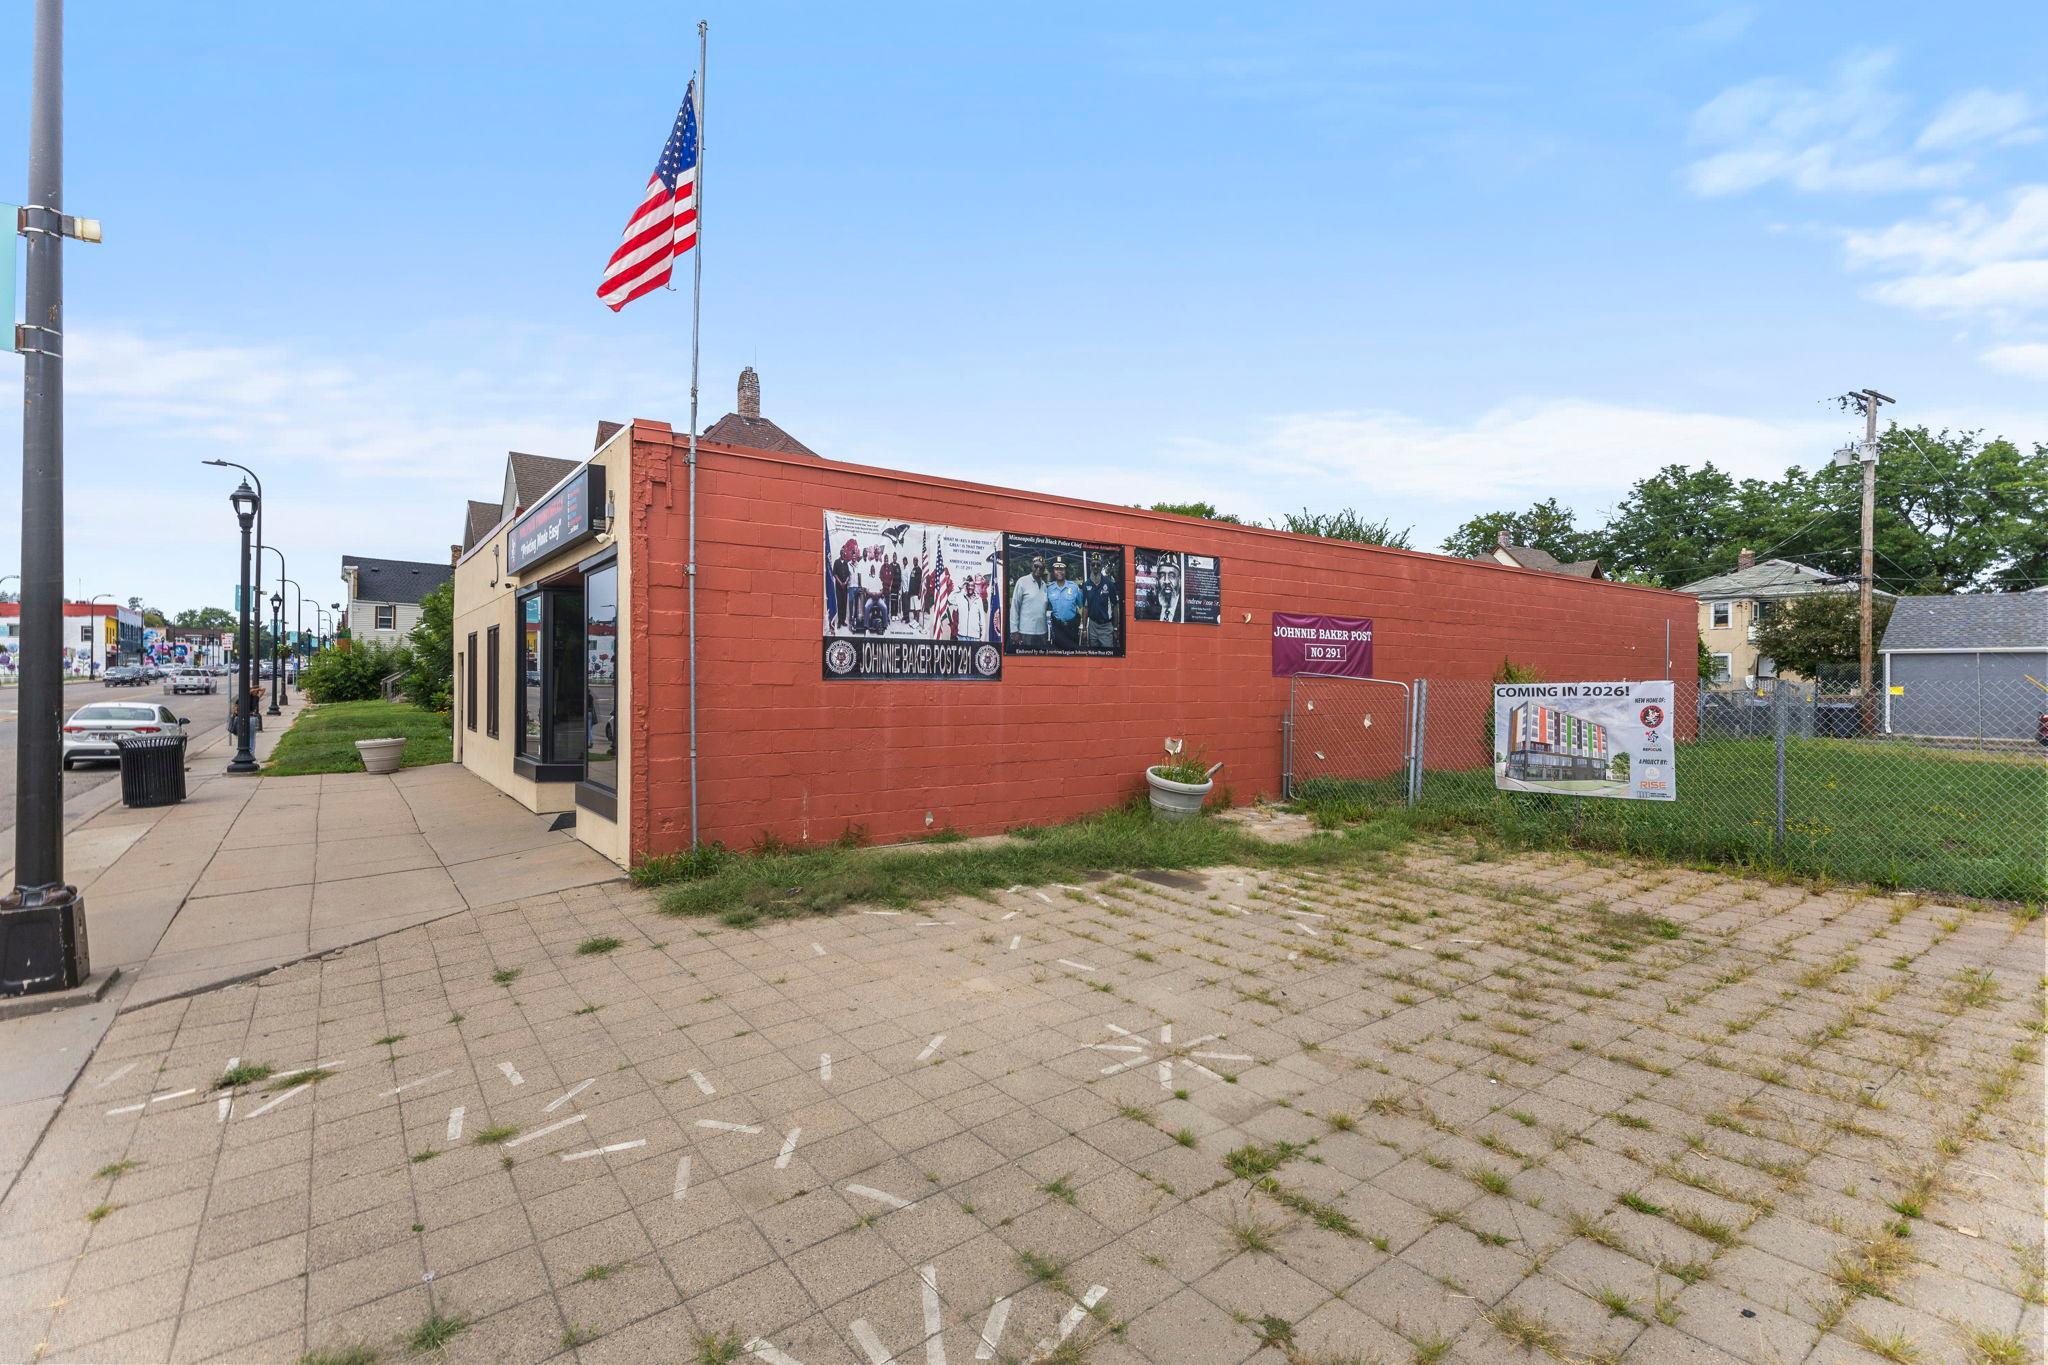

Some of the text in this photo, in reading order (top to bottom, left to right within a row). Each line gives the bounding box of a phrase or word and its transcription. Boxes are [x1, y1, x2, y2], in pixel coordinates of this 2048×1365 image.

[1045, 537, 1056, 545] Black
[1274, 626, 1372, 641] JOHNNIE BAKER POST
[859, 642, 901, 674] JOHNNIE
[902, 644, 932, 674] BAKER
[933, 645, 957, 674] POST
[958, 646, 972, 674] 291
[1311, 647, 1341, 658] NO 291
[1496, 685, 1630, 697] COMING IN 2026!
[1640, 781, 1666, 789] RISE
